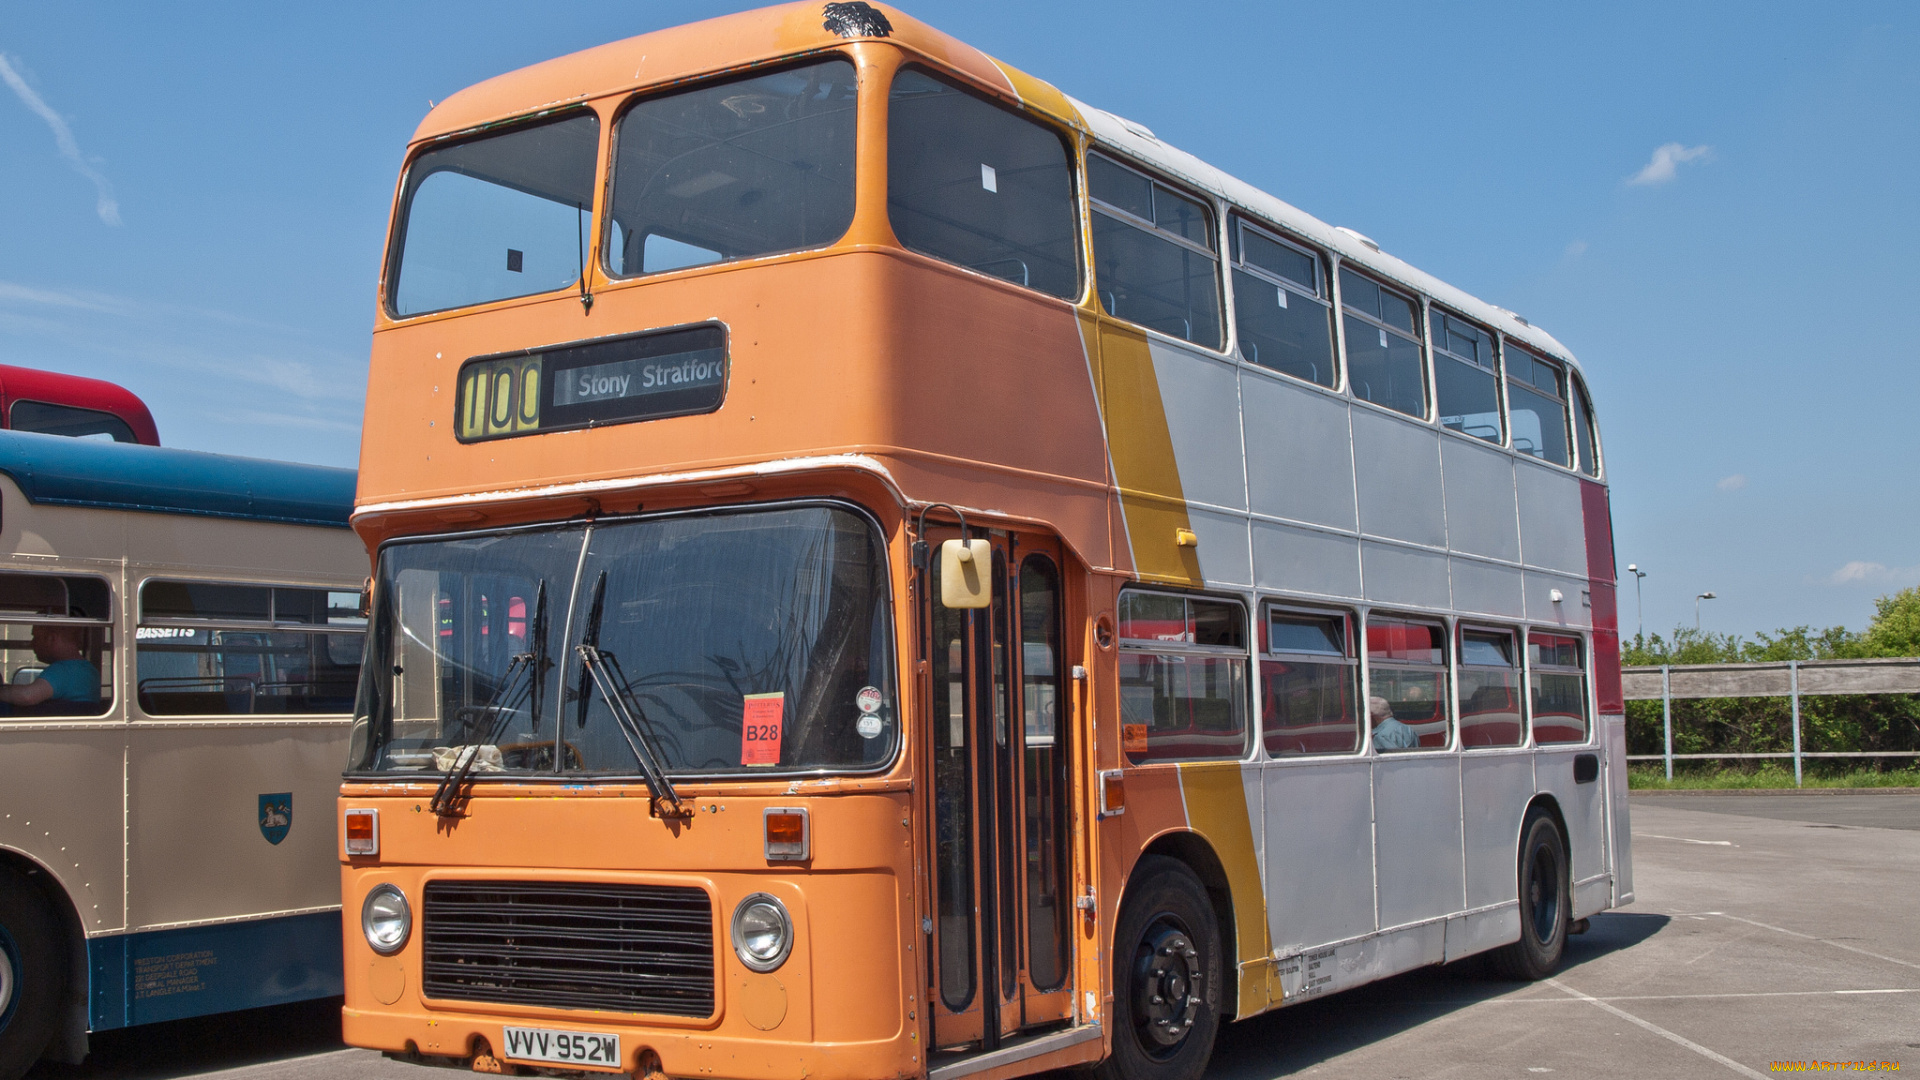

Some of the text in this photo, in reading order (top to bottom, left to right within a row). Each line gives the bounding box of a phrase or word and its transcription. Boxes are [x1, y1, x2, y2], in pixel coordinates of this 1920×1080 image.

[578, 373, 630, 397] Stony
[746, 724, 779, 742] B28
[507, 1030, 616, 1062] VVV 952W
